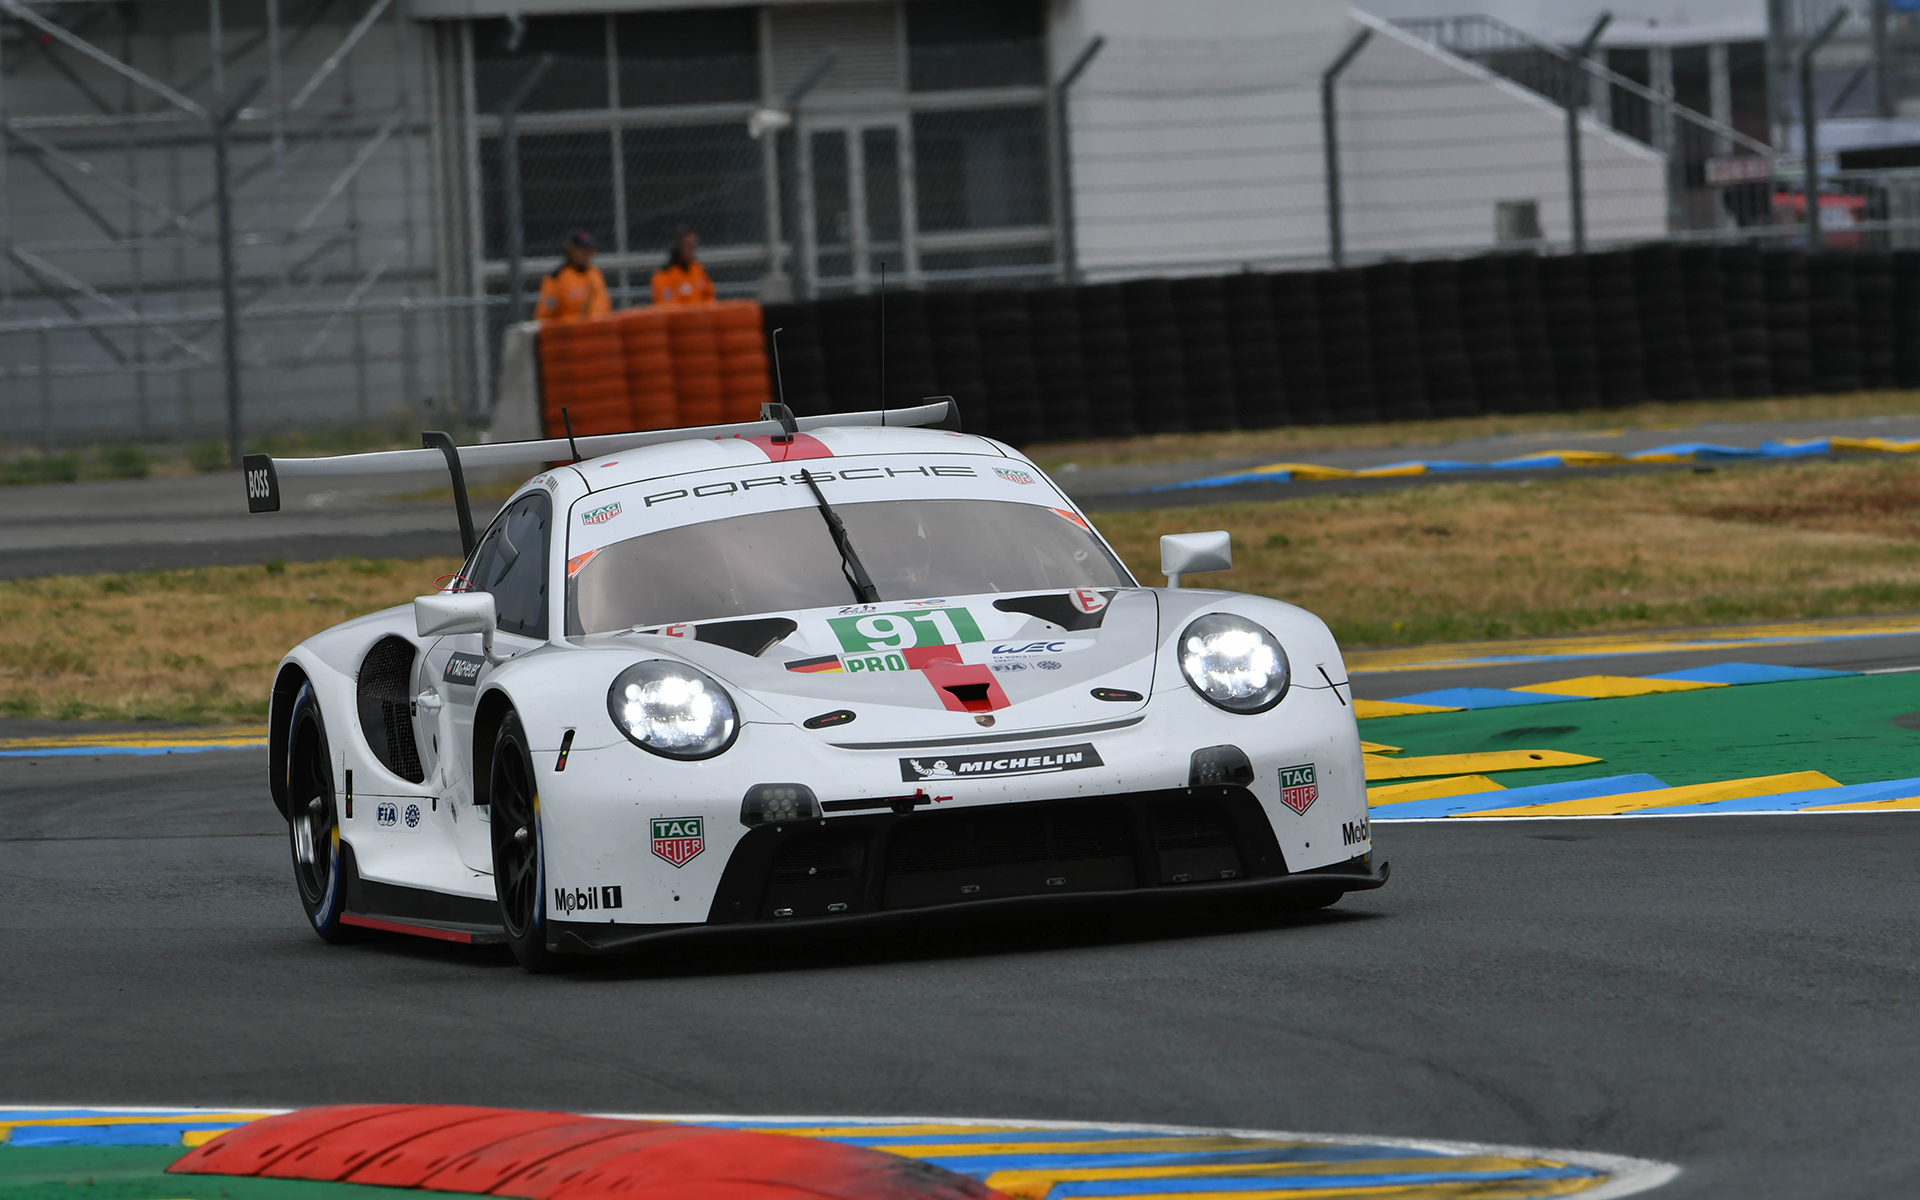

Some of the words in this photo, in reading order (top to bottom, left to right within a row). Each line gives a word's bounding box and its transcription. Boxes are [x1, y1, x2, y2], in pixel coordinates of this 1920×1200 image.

[248, 469, 270, 498] BOSS
[997, 469, 1029, 479] TAG
[644, 466, 977, 507] PORSCHE
[585, 505, 617, 518] TAG
[1076, 590, 1103, 611] E
[856, 611, 962, 651] 91
[992, 642, 1065, 654] WEC
[846, 654, 905, 673] PRO
[958, 752, 1083, 773] MICHELIN
[1283, 769, 1313, 786] TAG
[1283, 787, 1315, 811] HEUER
[656, 821, 698, 837] TAG
[655, 840, 701, 863] HEUER
[555, 887, 599, 911] Mobil
